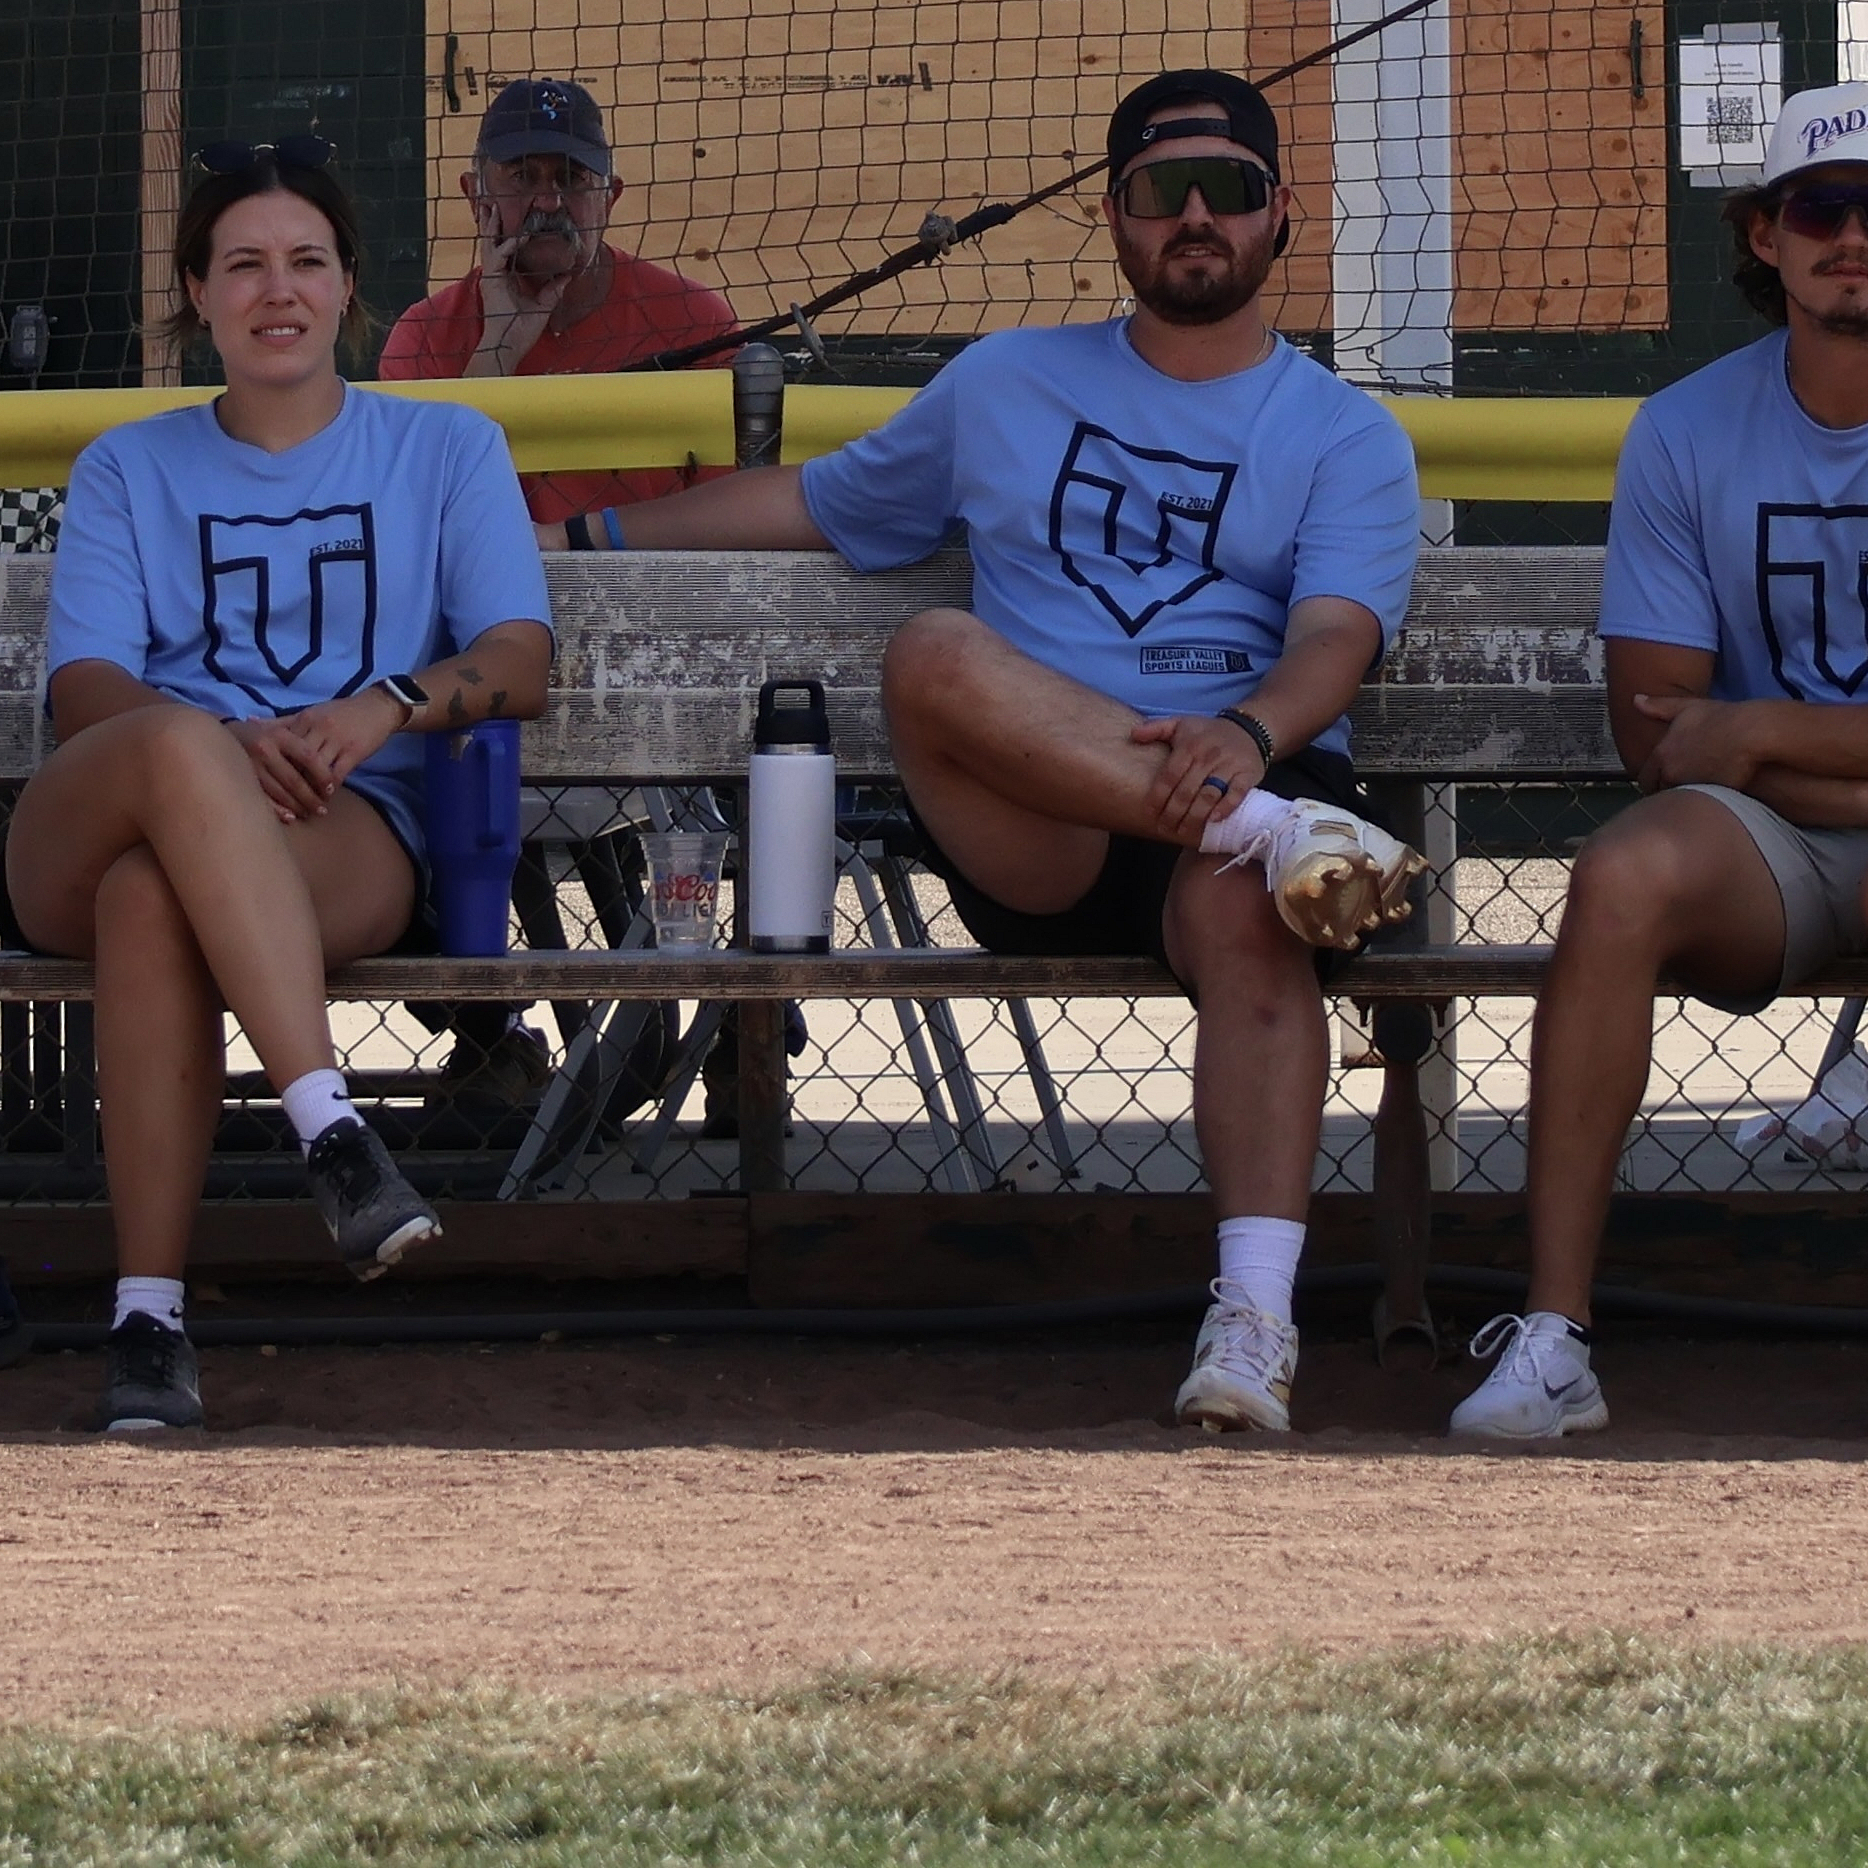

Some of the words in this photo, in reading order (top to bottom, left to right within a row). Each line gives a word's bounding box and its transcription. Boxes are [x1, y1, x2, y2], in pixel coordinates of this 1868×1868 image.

[1159, 491, 1184, 507] EST.
[1186, 496, 1213, 510] 2021
[334, 538, 364, 550] 2021
[1145, 649, 1192, 661] TREASURE
[1193, 650, 1223, 661] VALLEY
[1144, 660, 1183, 672] SPORTS
[1186, 661, 1225, 672] LEAGUES
